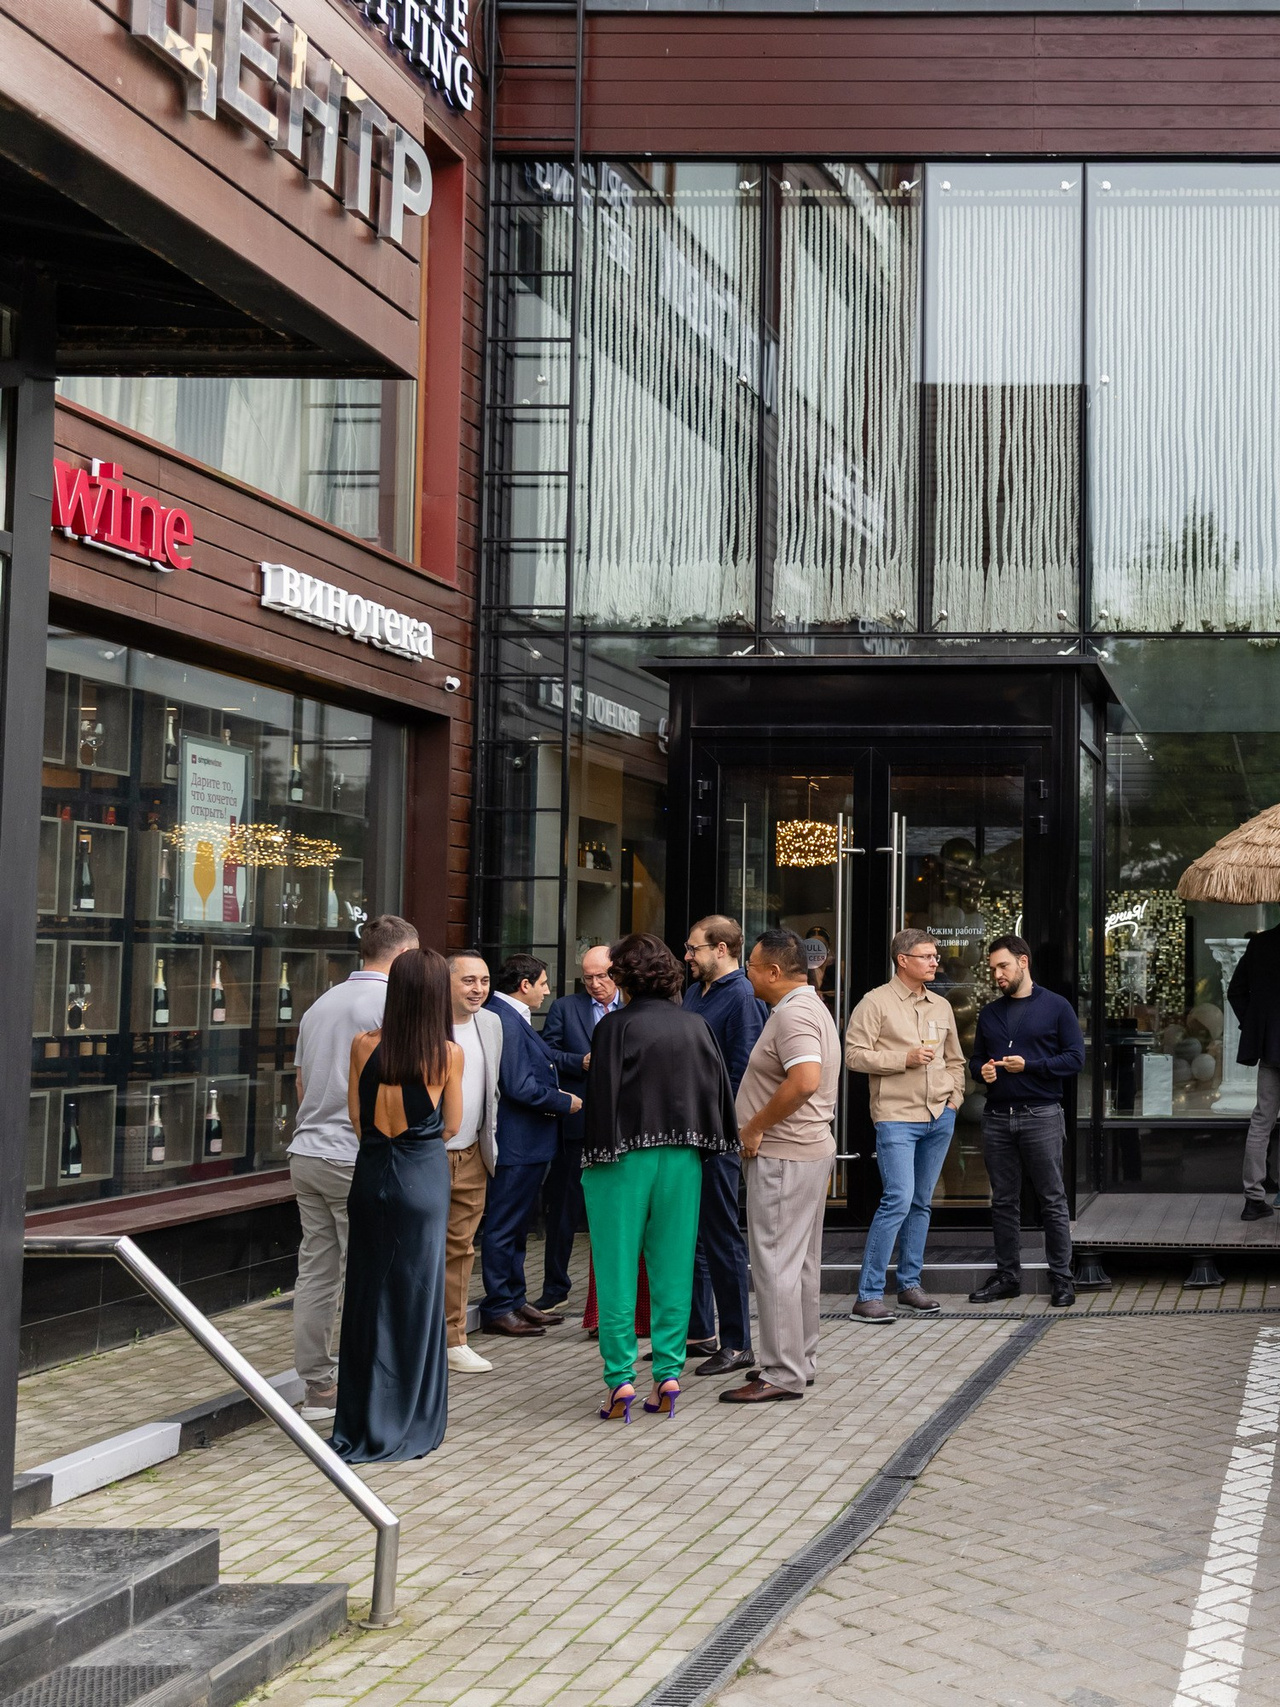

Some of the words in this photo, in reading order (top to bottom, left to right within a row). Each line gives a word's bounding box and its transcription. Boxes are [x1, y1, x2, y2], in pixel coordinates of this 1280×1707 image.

[191, 772, 221, 791] Дарите
[223, 781, 234, 794] то,
[191, 790, 206, 802] что
[207, 793, 238, 807] хочется
[190, 805, 228, 820] открыть!
[926, 926, 953, 936] Режим
[934, 939, 970, 948] едневно
